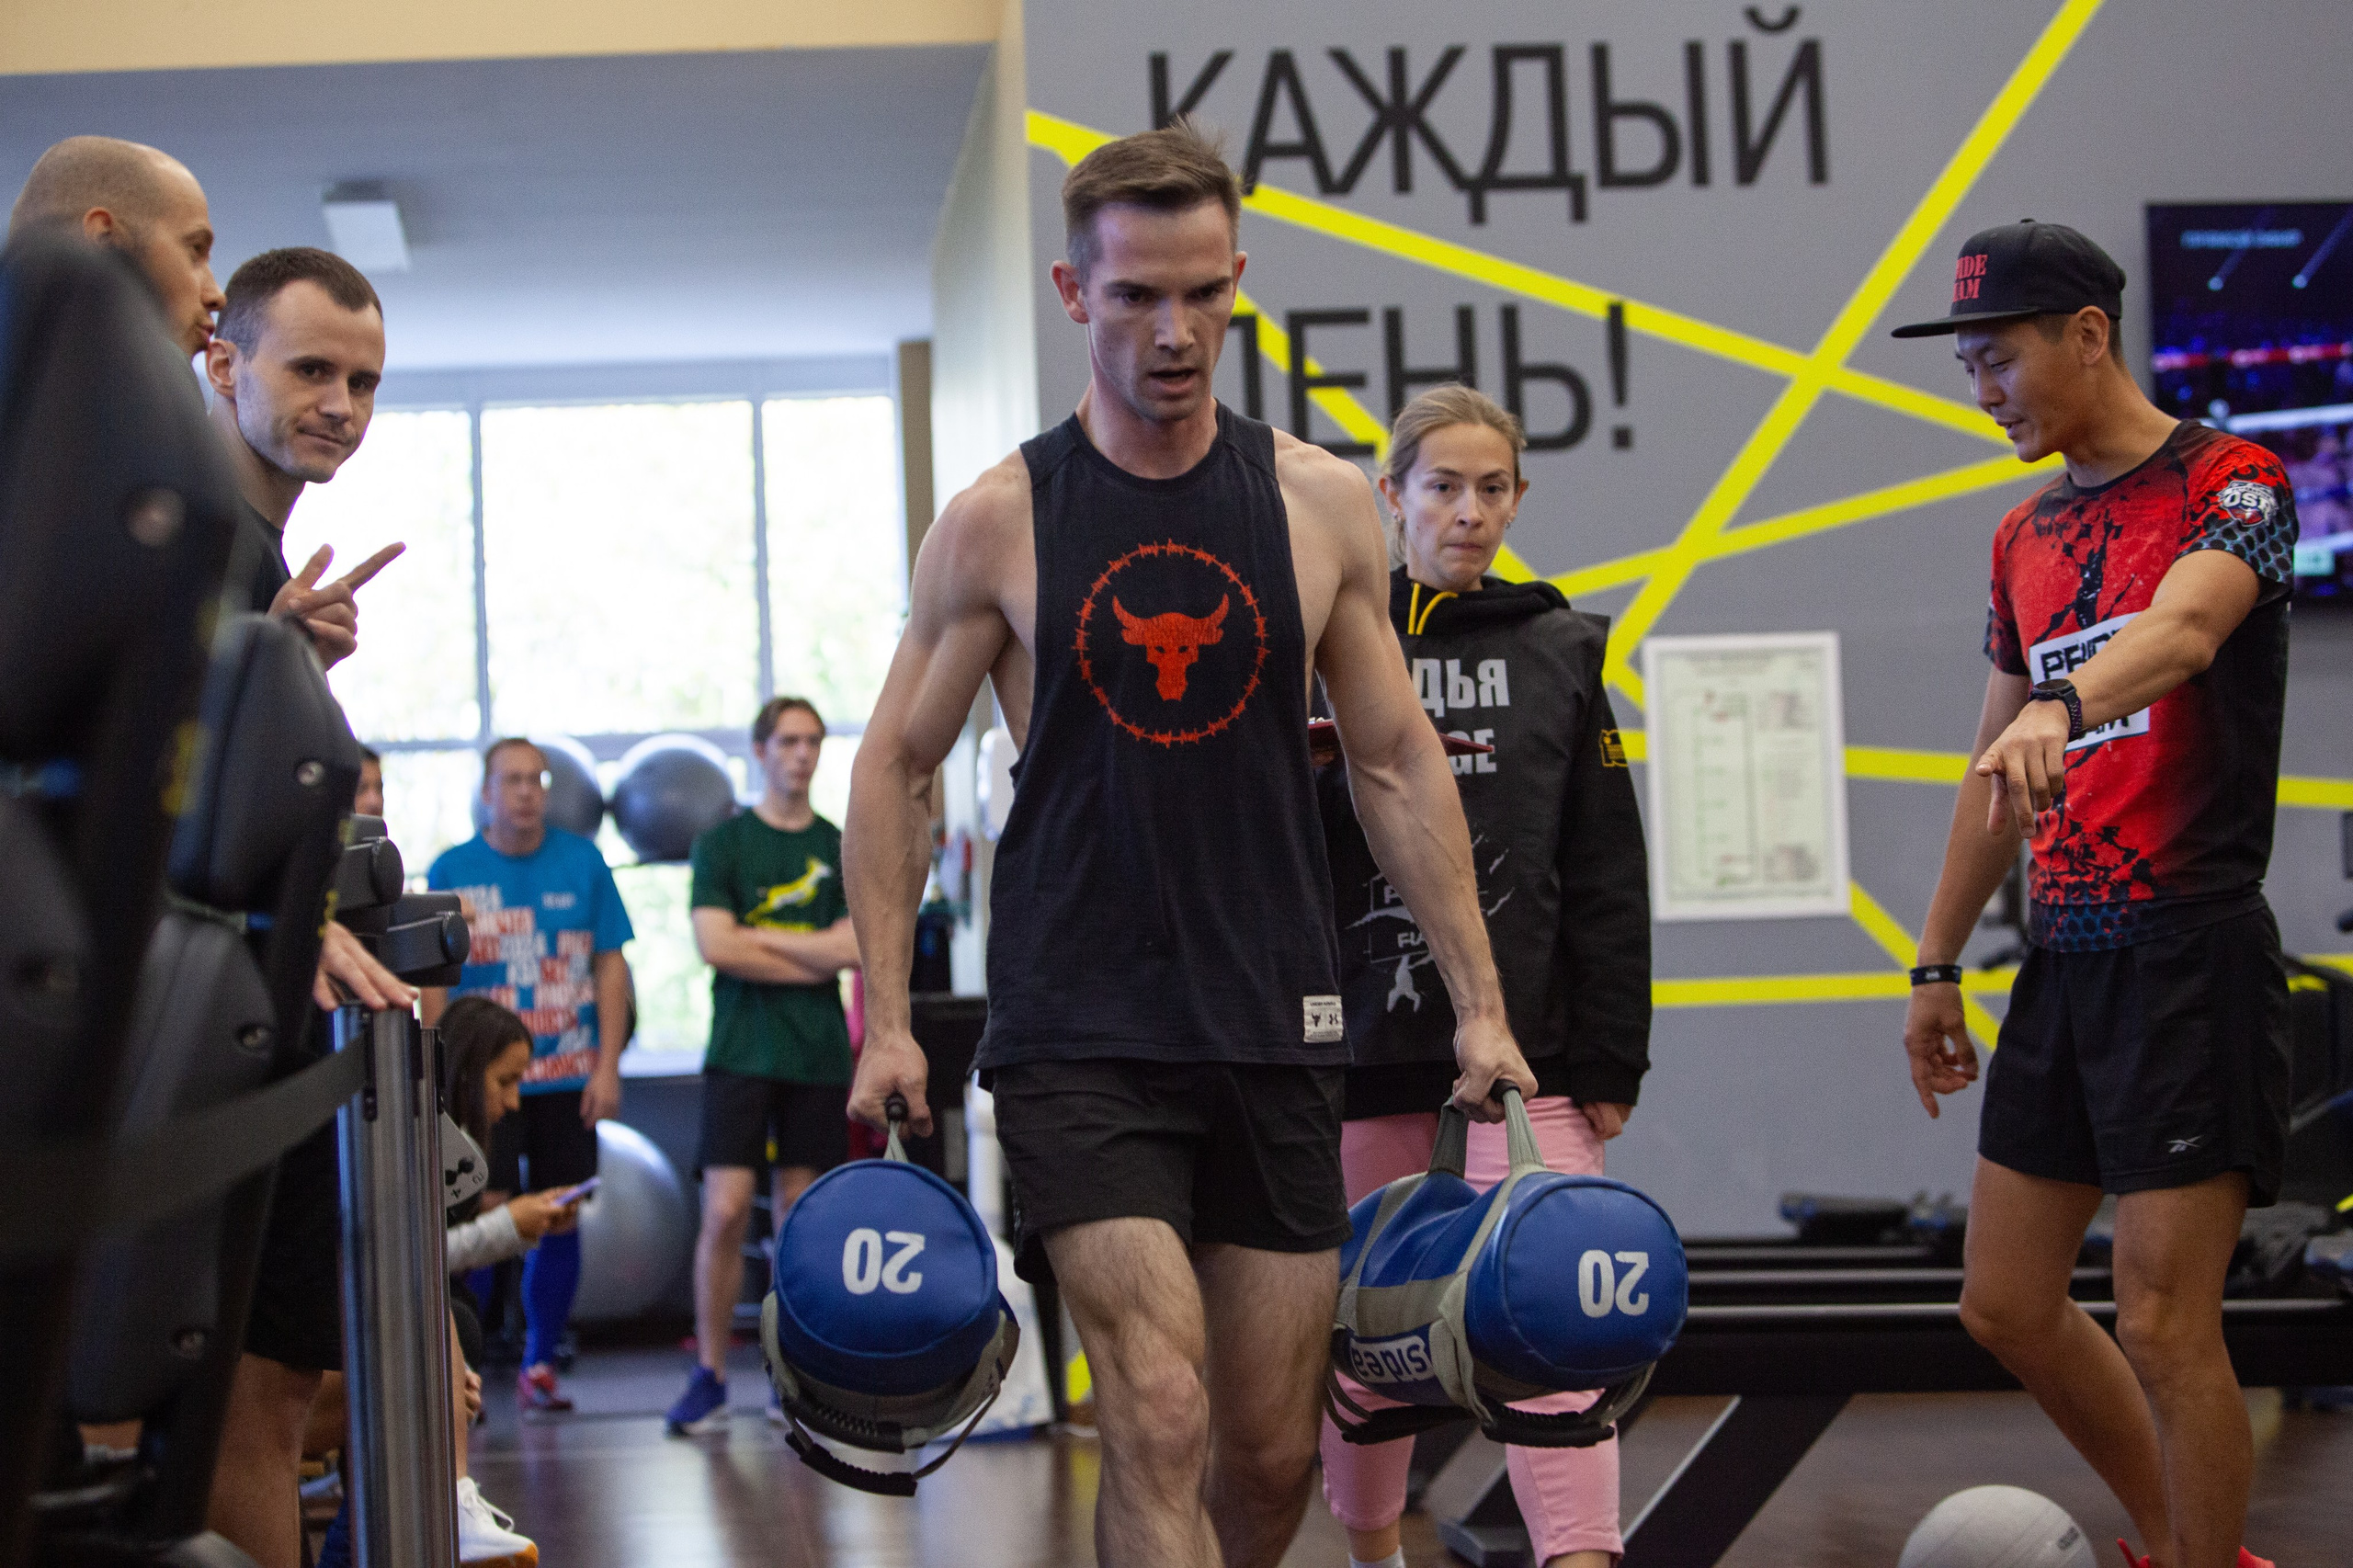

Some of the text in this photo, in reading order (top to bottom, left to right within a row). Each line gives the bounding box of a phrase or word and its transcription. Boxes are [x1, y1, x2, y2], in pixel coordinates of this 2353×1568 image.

[1149, 6, 1830, 226] КАЖДЫЙ
[1412, 658, 1510, 718] ДЬЯ
[842, 1228, 926, 1295] 20
[1578, 1249, 1650, 1318] 20
